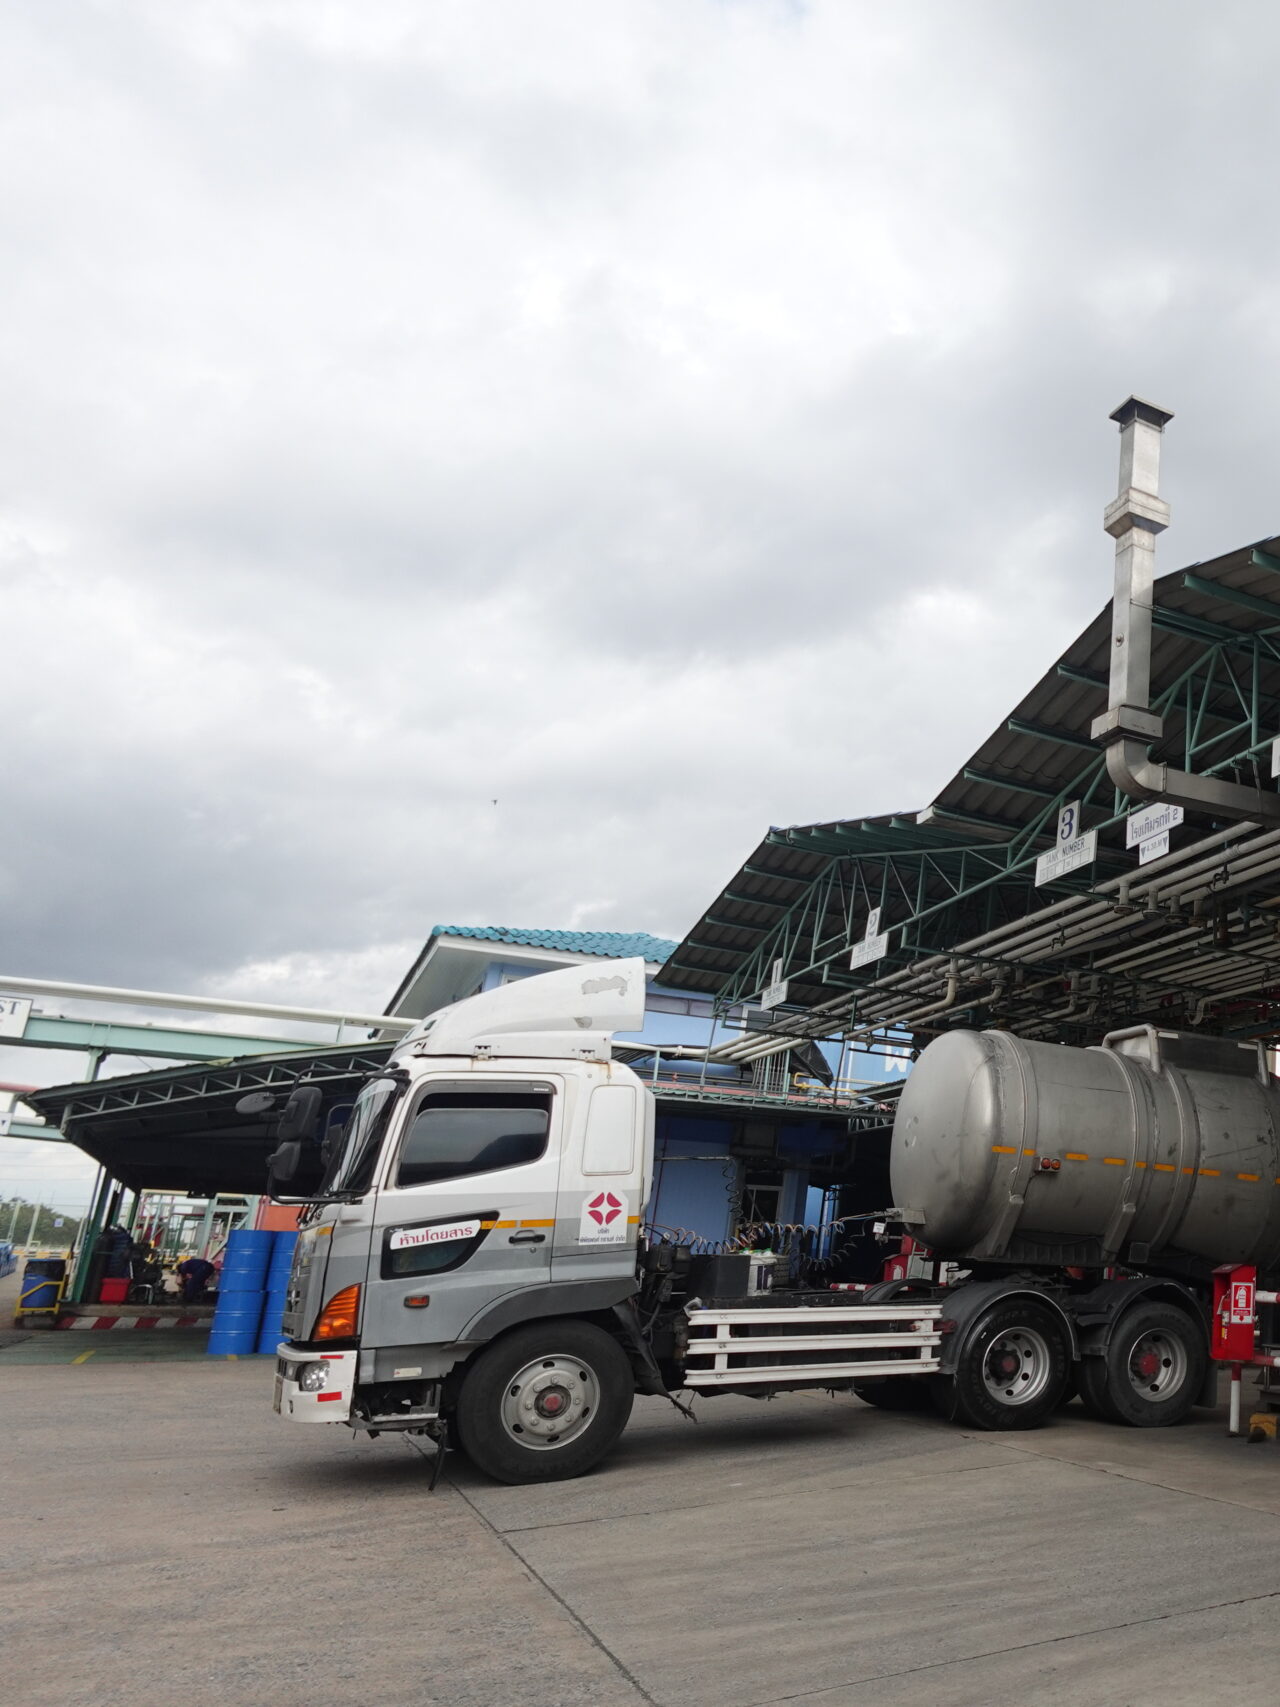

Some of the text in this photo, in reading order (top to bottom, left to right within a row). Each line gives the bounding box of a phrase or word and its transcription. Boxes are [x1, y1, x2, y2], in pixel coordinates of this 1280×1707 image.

[1060, 808, 1075, 840] 3
[1172, 807, 1179, 821] 2
[1062, 837, 1085, 857] NUMBER
[868, 912, 877, 937] 2
[399, 1226, 473, 1246] ห้ามโดยสาร
